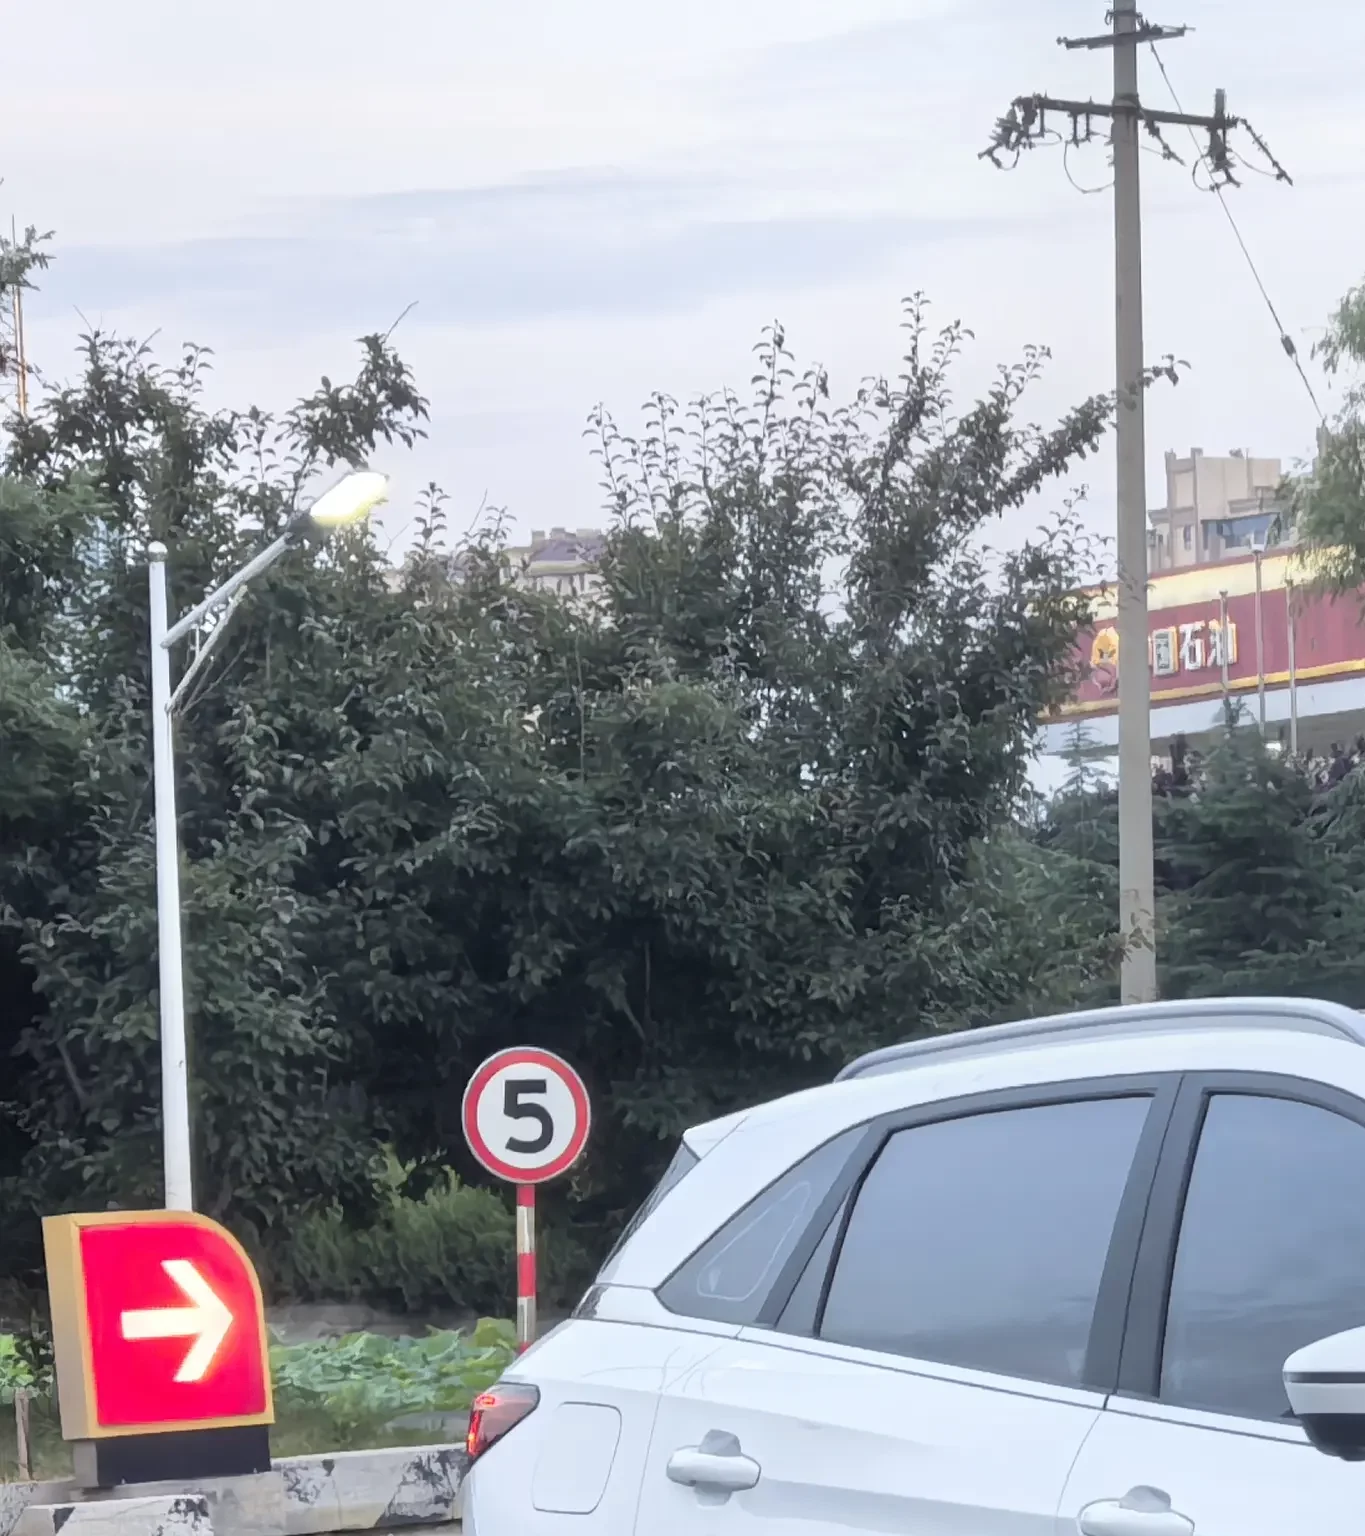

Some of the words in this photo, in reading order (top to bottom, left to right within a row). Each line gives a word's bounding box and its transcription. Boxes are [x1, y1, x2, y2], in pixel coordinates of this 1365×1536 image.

[1148, 614, 1238, 677] 国石油
[503, 1079, 554, 1154] 5
